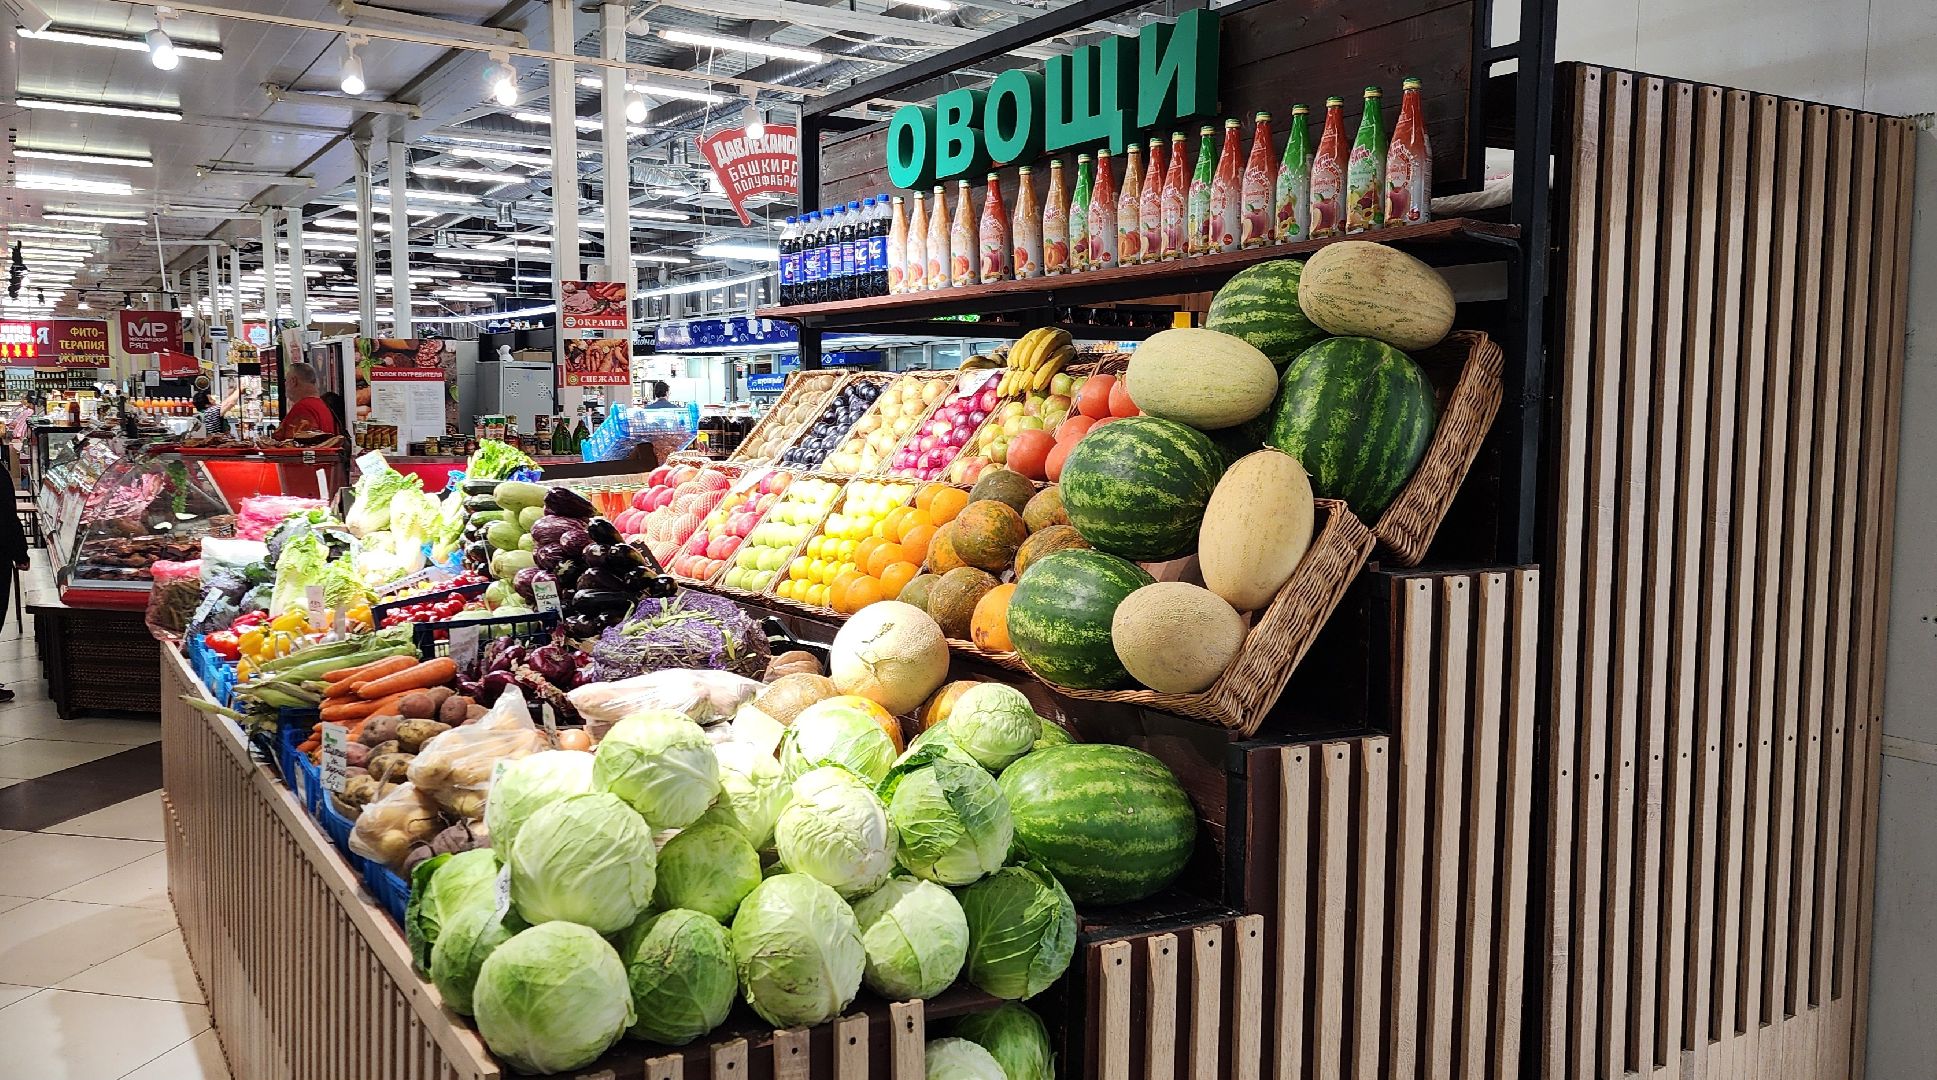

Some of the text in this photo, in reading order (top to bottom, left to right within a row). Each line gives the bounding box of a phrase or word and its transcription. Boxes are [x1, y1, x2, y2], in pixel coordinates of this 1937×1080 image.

[887, 14, 1208, 190] ОВОЩИ
[712, 133, 797, 169] ДАВЛЕКАНО
[727, 158, 797, 182] БАШКИРС
[733, 174, 797, 195] ПОЛУФАБРИ
[577, 318, 626, 327] ОКРАИНА
[59, 340, 105, 351] ТЕРАПИЯ
